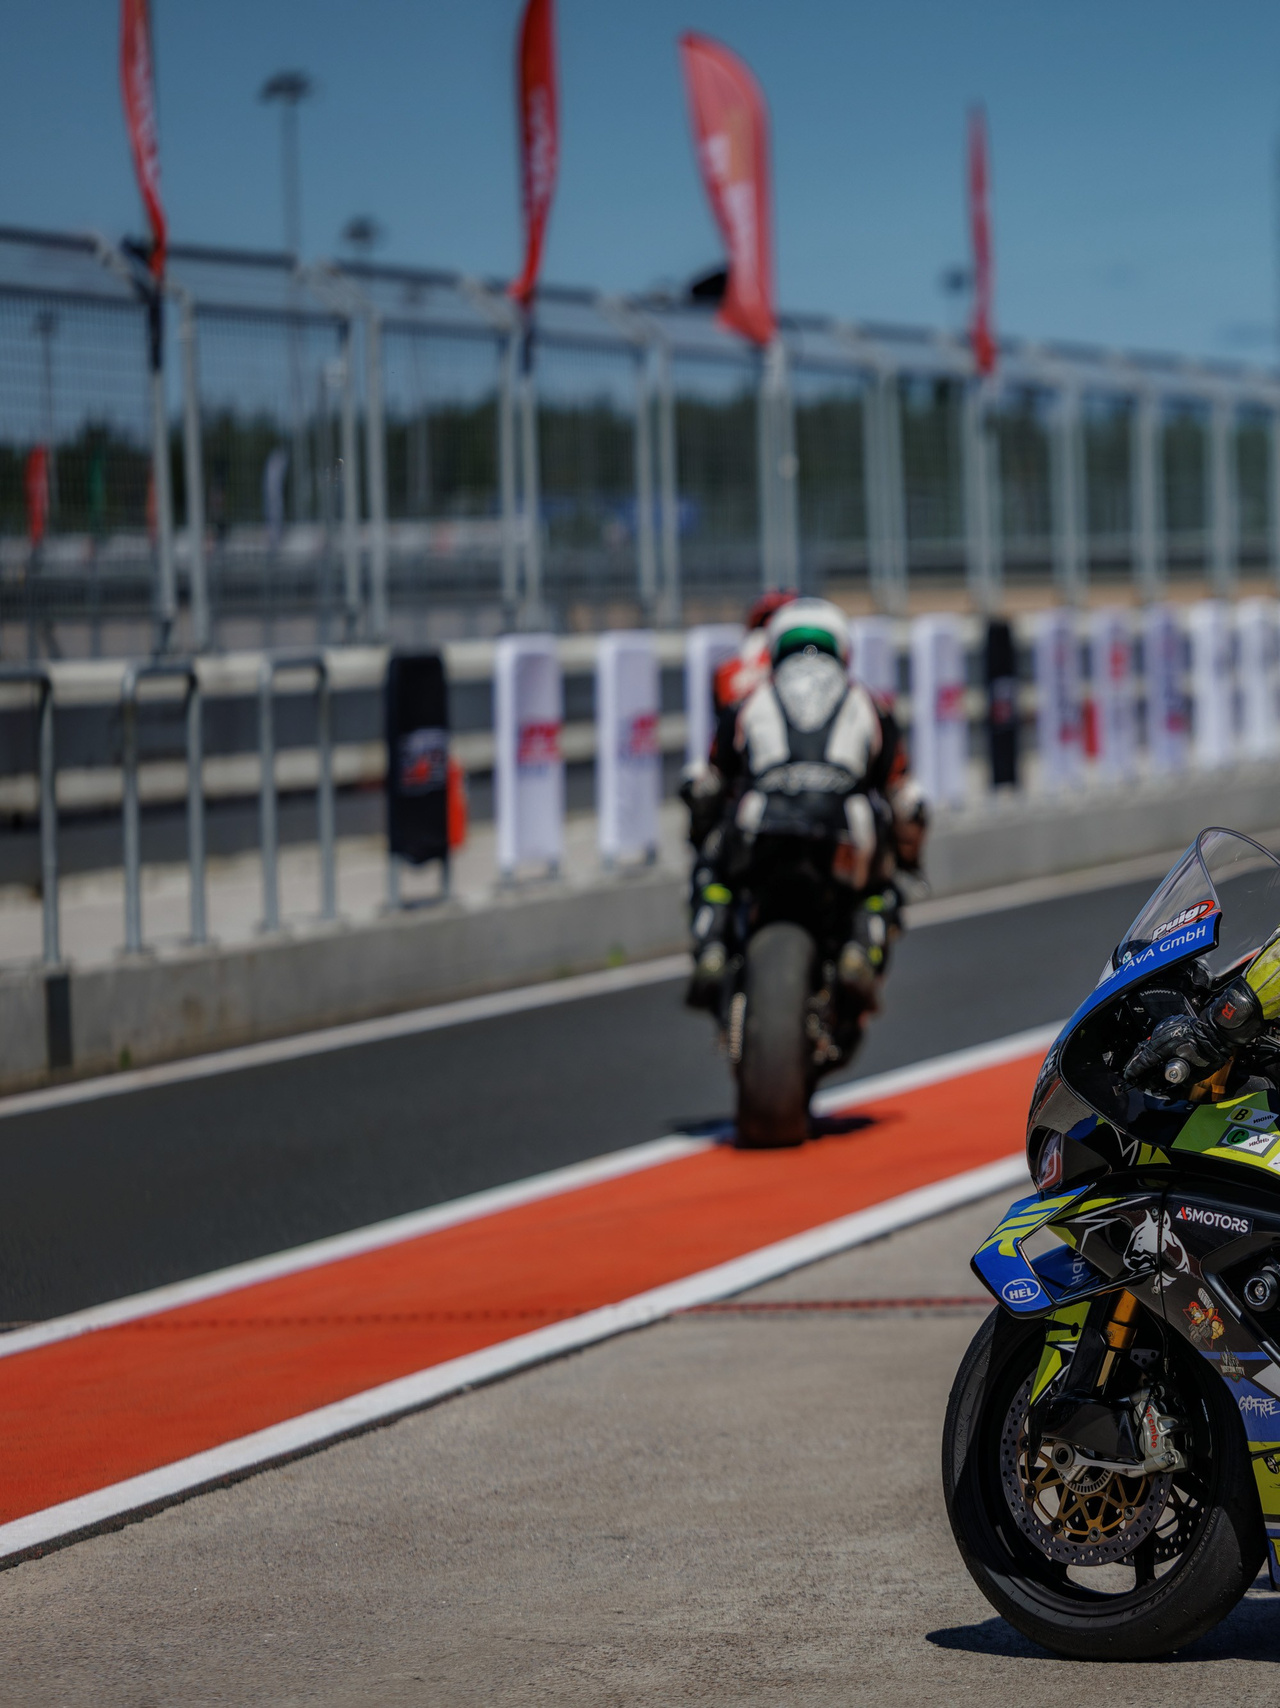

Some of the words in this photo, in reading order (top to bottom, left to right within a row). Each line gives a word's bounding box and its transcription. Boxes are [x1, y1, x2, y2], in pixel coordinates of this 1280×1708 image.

[1152, 905, 1200, 941] Puig
[1124, 948, 1155, 971] AvA
[1160, 925, 1206, 952] GmbH
[1234, 1109, 1249, 1121] B
[1231, 1131, 1246, 1143] C
[1009, 1287, 1035, 1300] HEL
[1146, 1405, 1159, 1449] brembo
